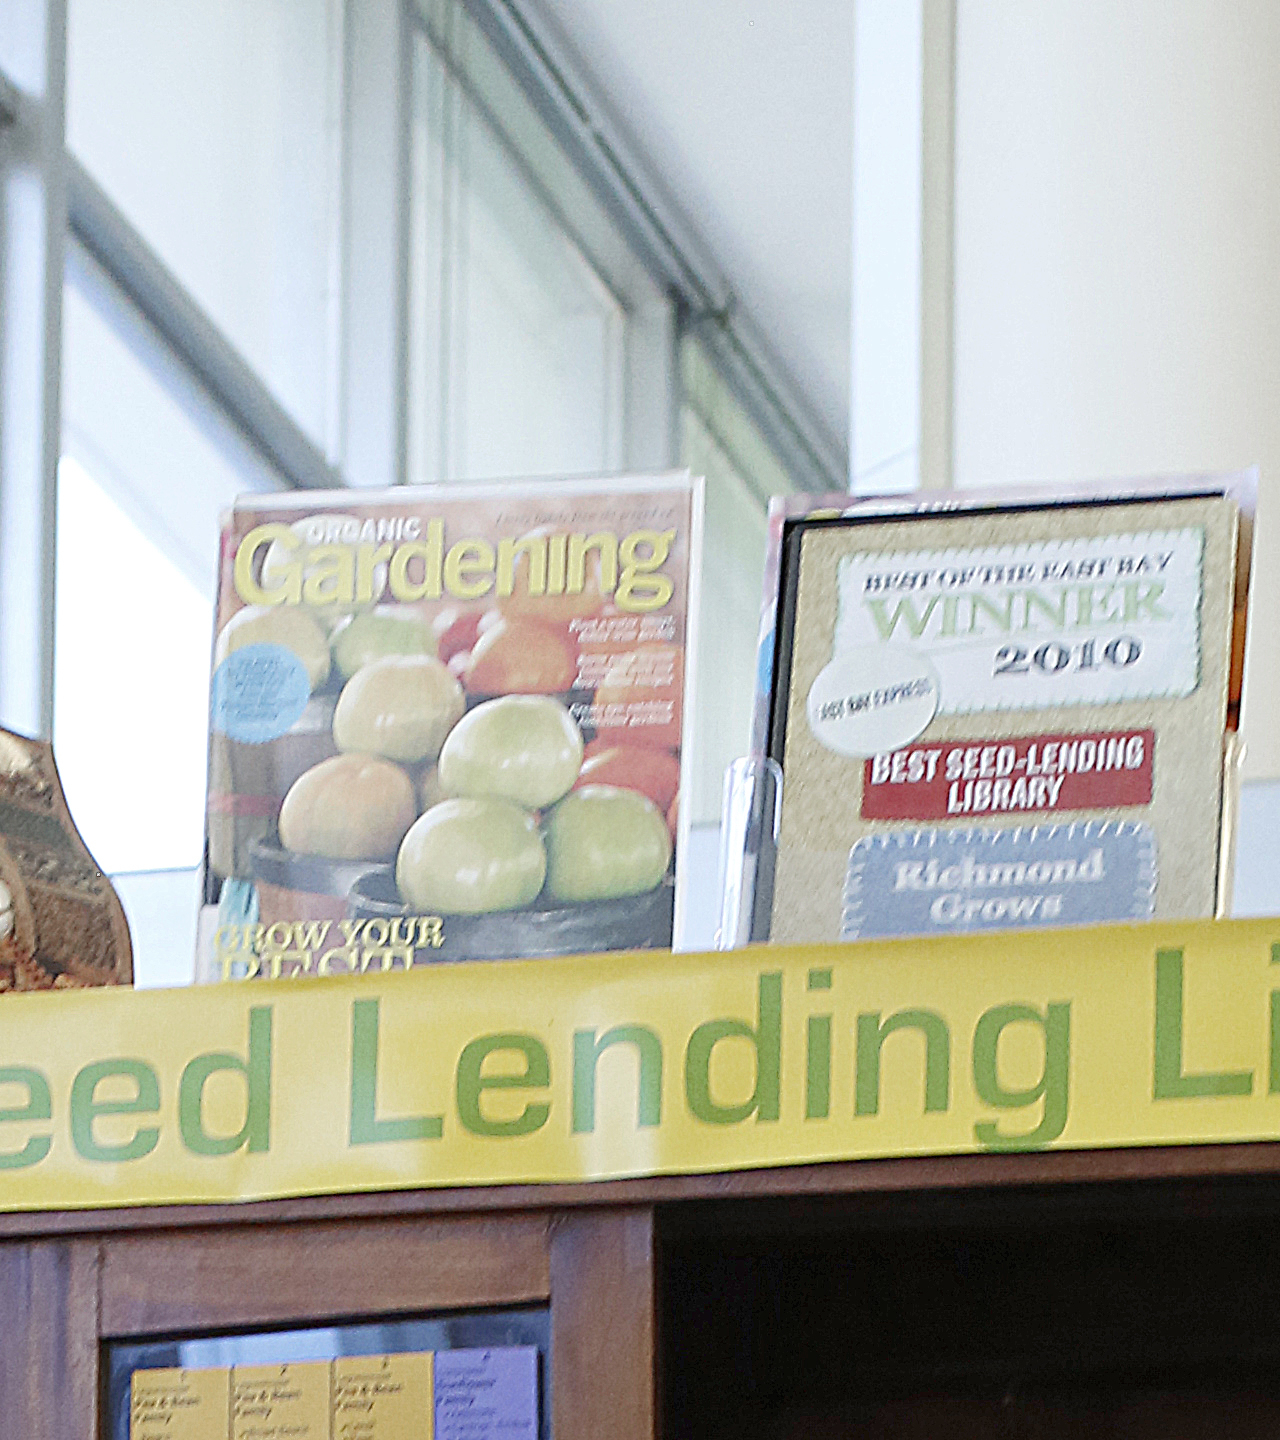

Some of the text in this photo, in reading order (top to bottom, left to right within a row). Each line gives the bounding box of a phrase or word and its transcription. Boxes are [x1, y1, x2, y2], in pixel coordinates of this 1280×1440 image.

[305, 517, 422, 543] ORGANIC
[233, 517, 677, 612] Gardening
[863, 579, 1174, 641] WINNER
[993, 635, 1145, 678] 2010
[871, 735, 1145, 785] BEST SEED-LENDING
[947, 773, 1065, 814] LIBRARY
[893, 847, 1105, 892] Richmond
[929, 893, 1064, 924] Grows
[215, 916, 447, 952] GROW YOUR
[348, 967, 1073, 1153] Lending
